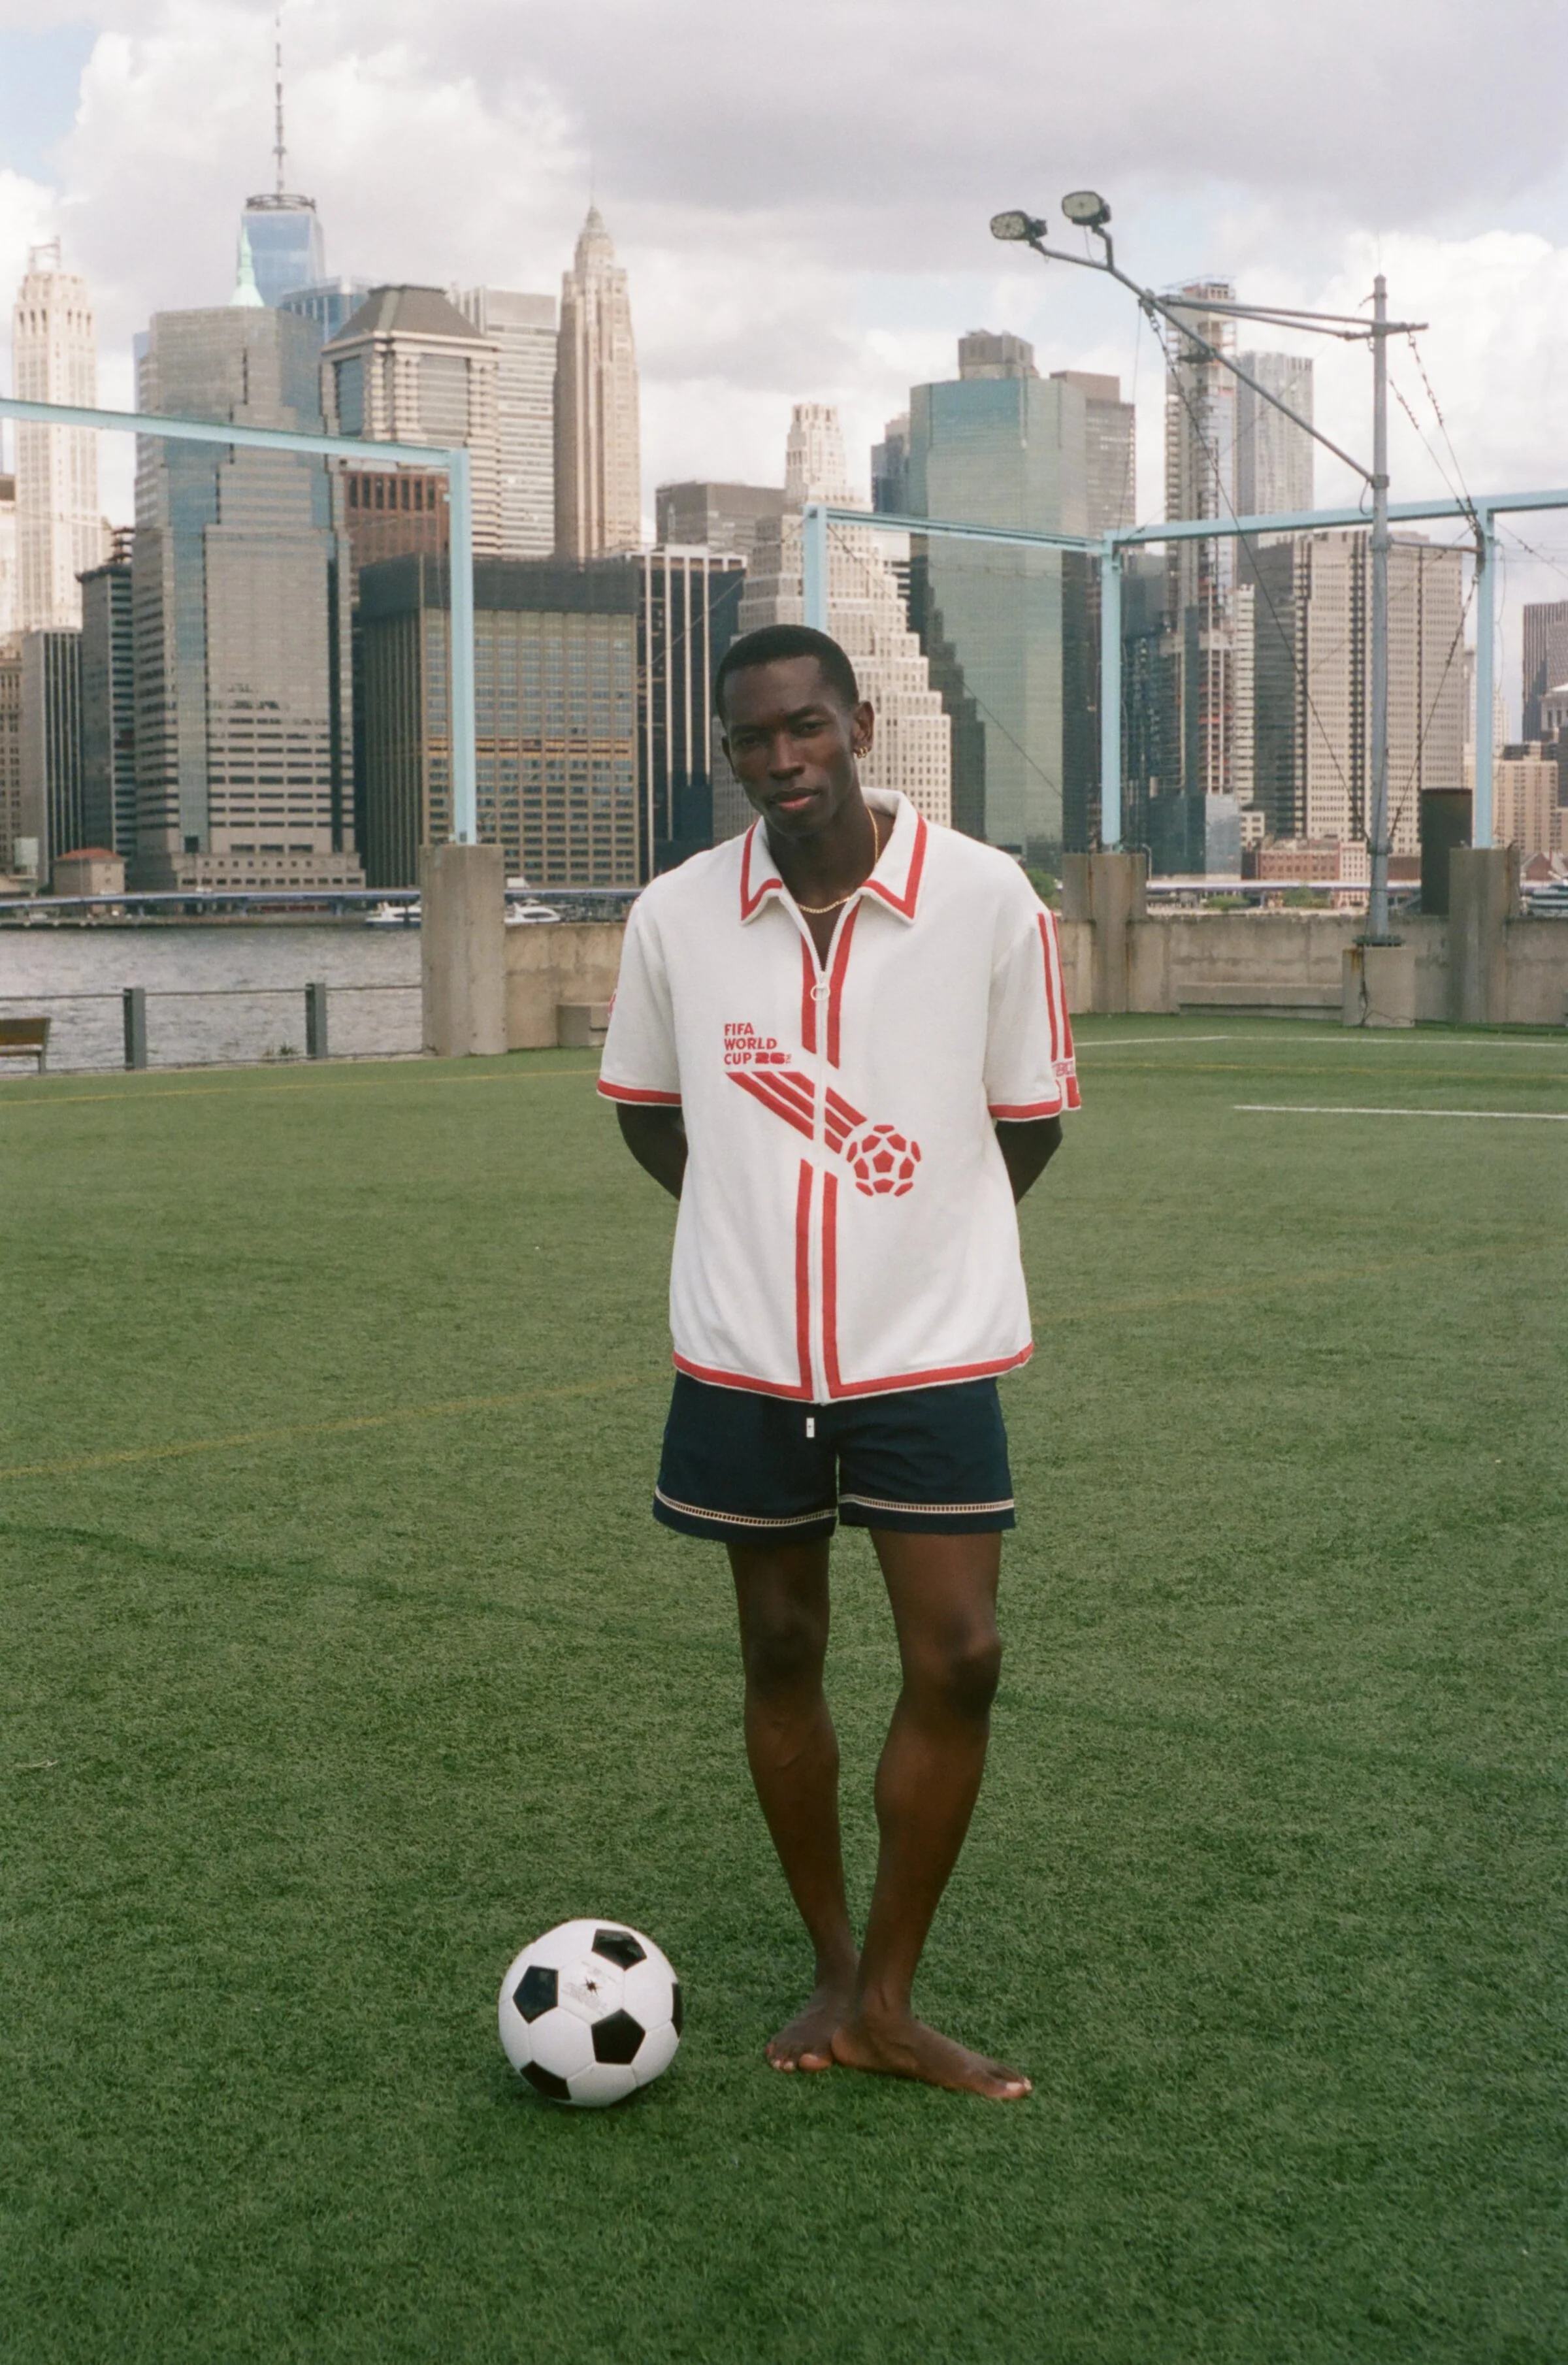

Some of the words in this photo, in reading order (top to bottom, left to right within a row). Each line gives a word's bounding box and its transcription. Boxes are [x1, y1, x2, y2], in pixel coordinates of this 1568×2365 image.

[724, 1022, 754, 1036] FIFA
[724, 1037, 777, 1051] WORLD
[724, 1052, 752, 1065] CUP
